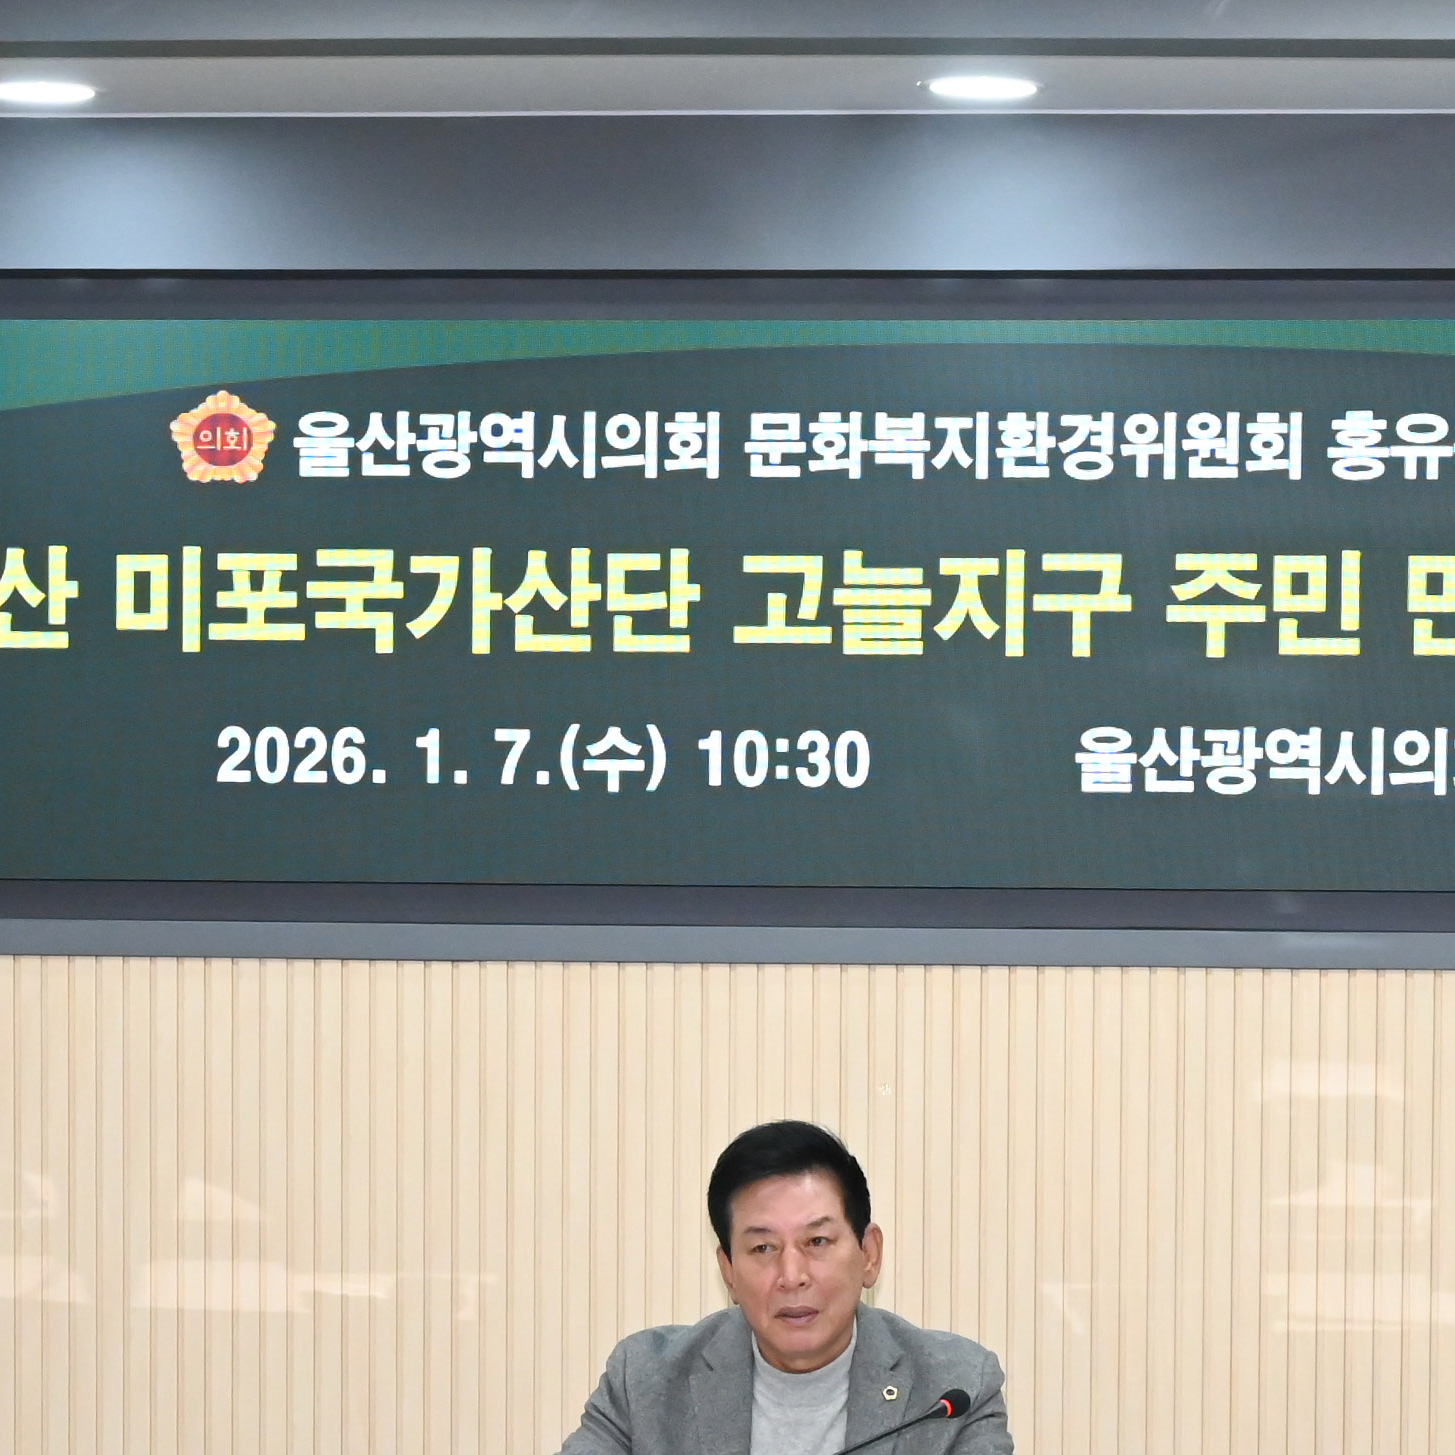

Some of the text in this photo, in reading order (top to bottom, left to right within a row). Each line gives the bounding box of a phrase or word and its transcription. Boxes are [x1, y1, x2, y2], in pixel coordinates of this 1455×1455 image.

[196, 427, 248, 451] 의회
[293, 411, 721, 480] 울산광역시의회
[745, 412, 1303, 481] 문화복지환경위원회
[116, 546, 701, 655] 미포국가산단
[734, 549, 1133, 658] 고늘지구
[1166, 550, 1361, 659] 주민
[217, 723, 871, 793] 2026. 1. 7.(수) 10:30
